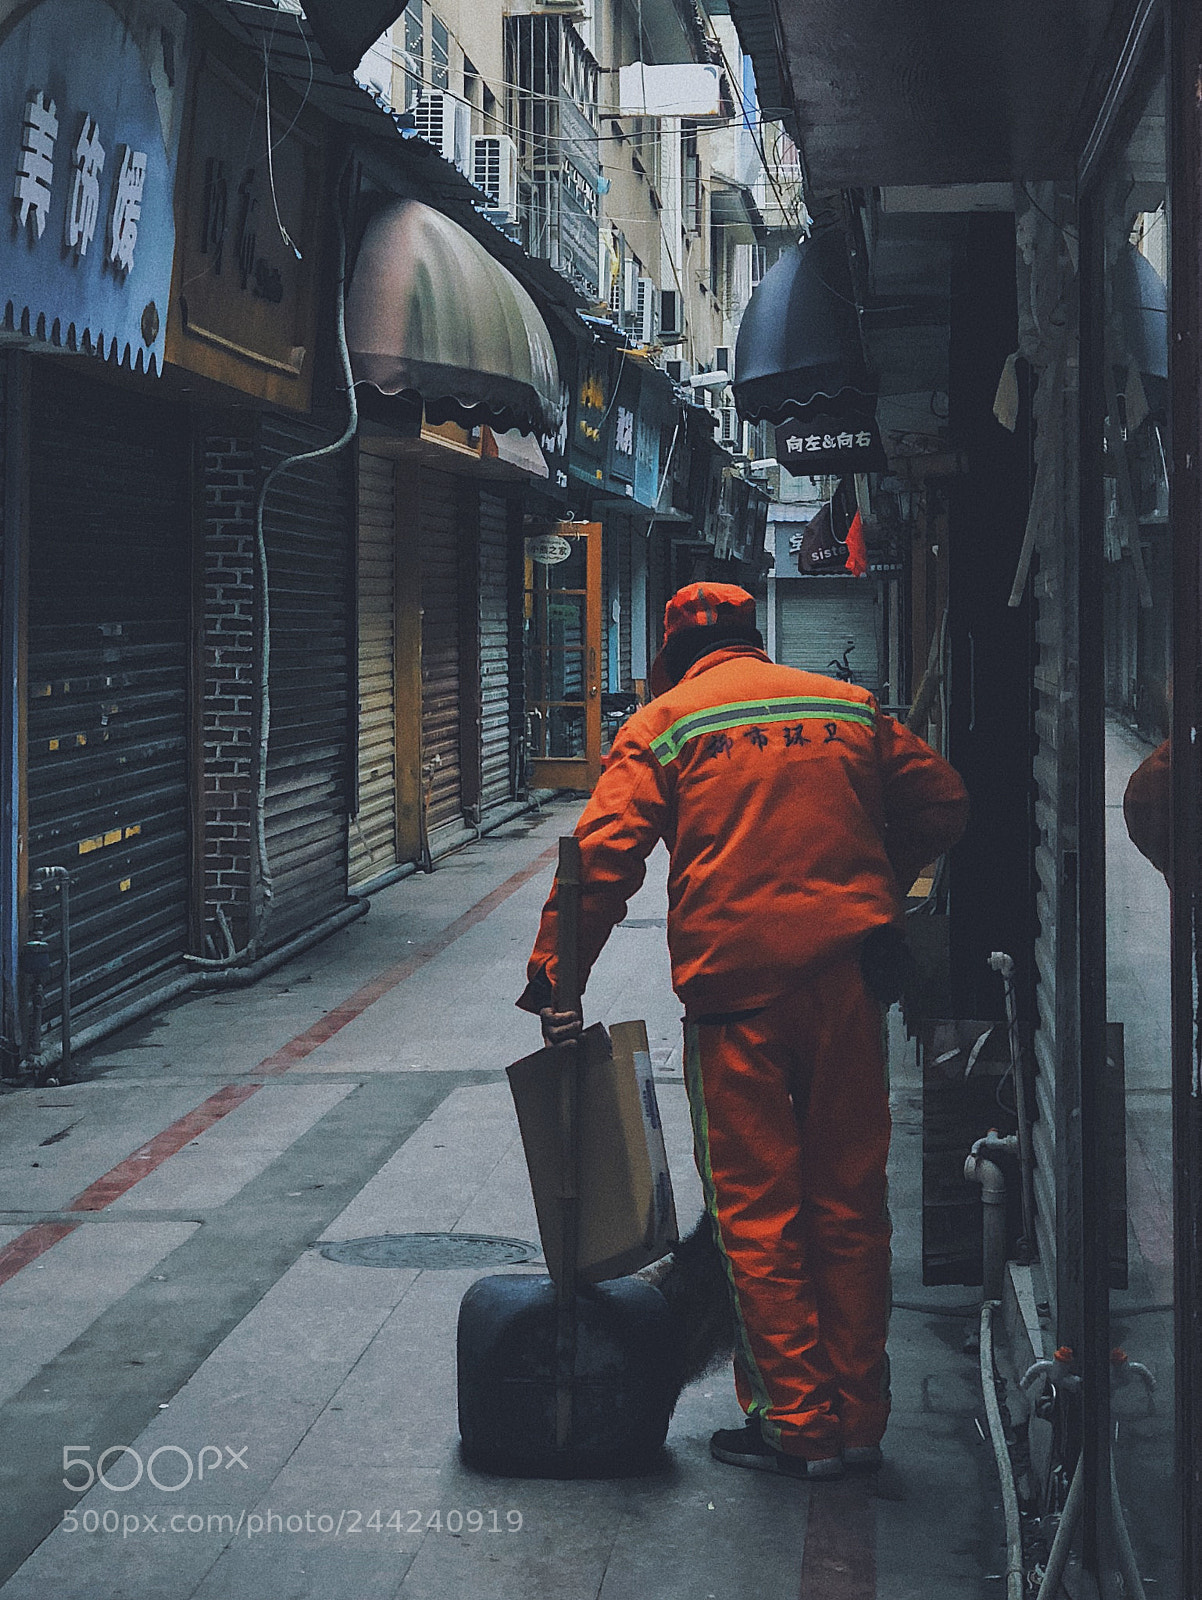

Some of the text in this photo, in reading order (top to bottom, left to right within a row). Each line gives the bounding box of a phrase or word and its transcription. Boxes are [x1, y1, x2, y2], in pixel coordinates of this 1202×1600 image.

[785, 430, 872, 454] 向左&向右
[811, 545, 847, 562] siste
